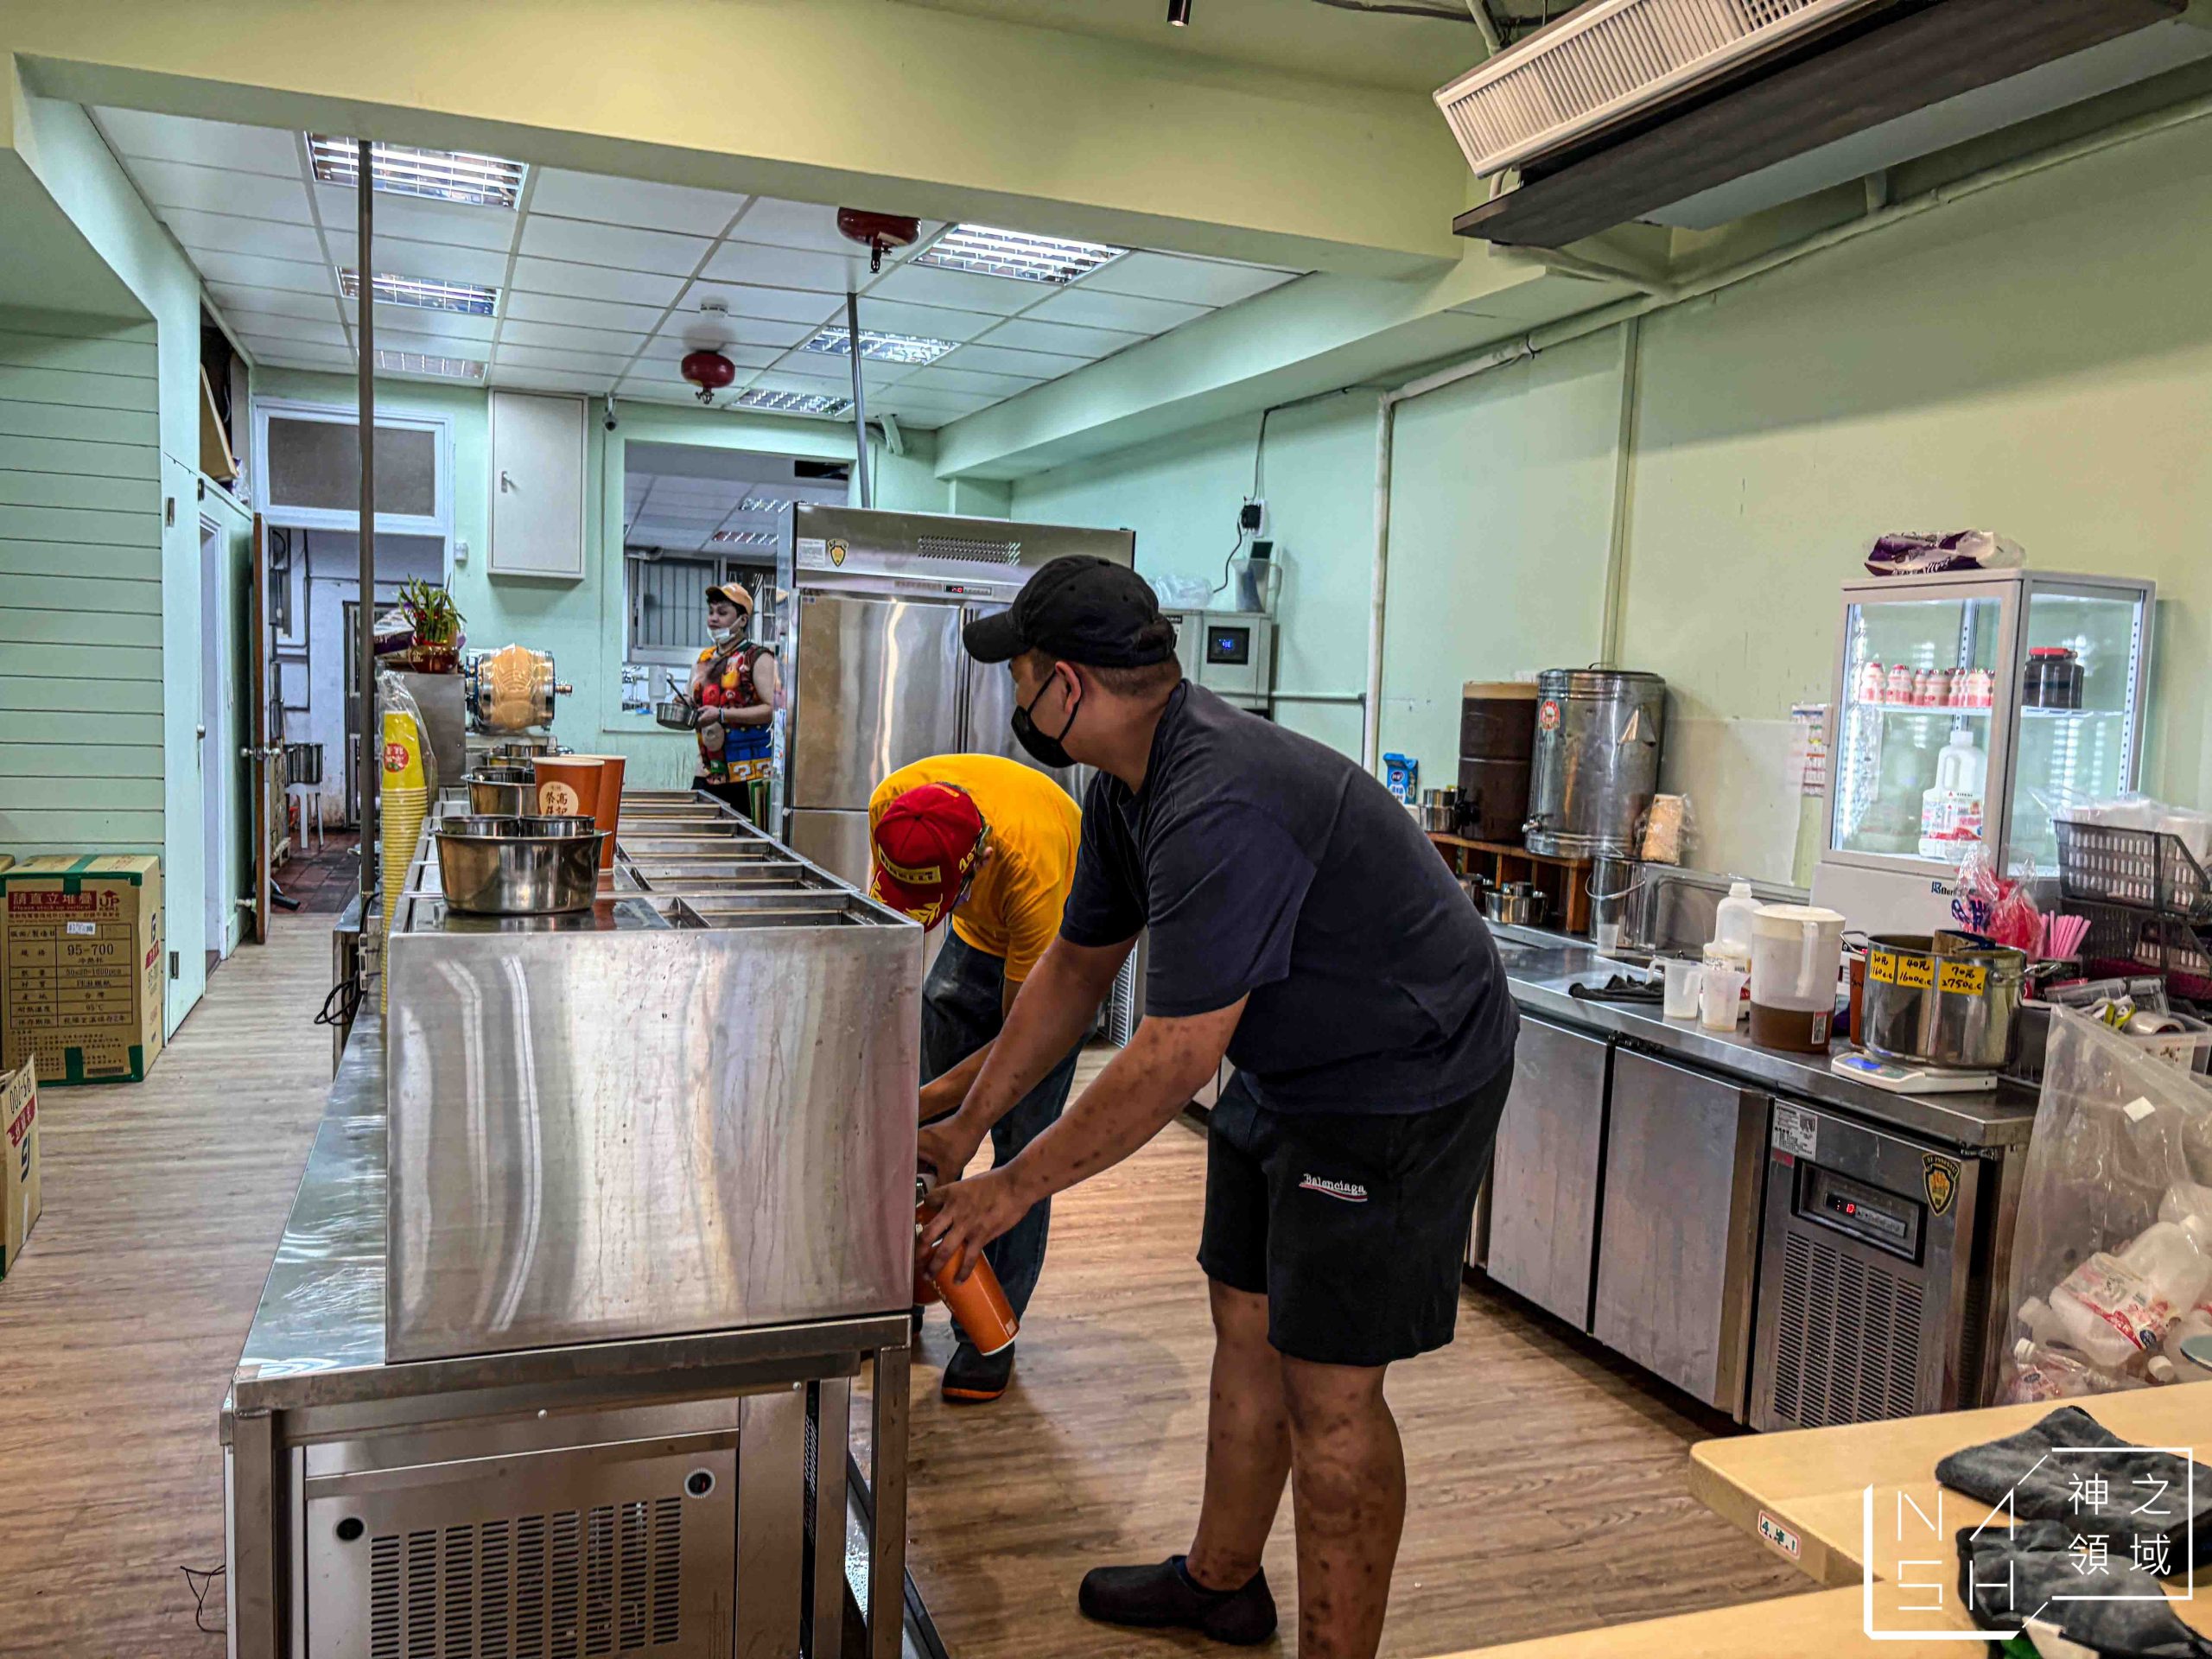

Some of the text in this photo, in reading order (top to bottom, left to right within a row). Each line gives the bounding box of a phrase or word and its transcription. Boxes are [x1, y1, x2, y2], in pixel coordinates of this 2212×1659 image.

[99, 898, 120, 906] UP
[67, 943, 114, 956] 95-700
[1303, 1173, 1366, 1196] Balenciaga
